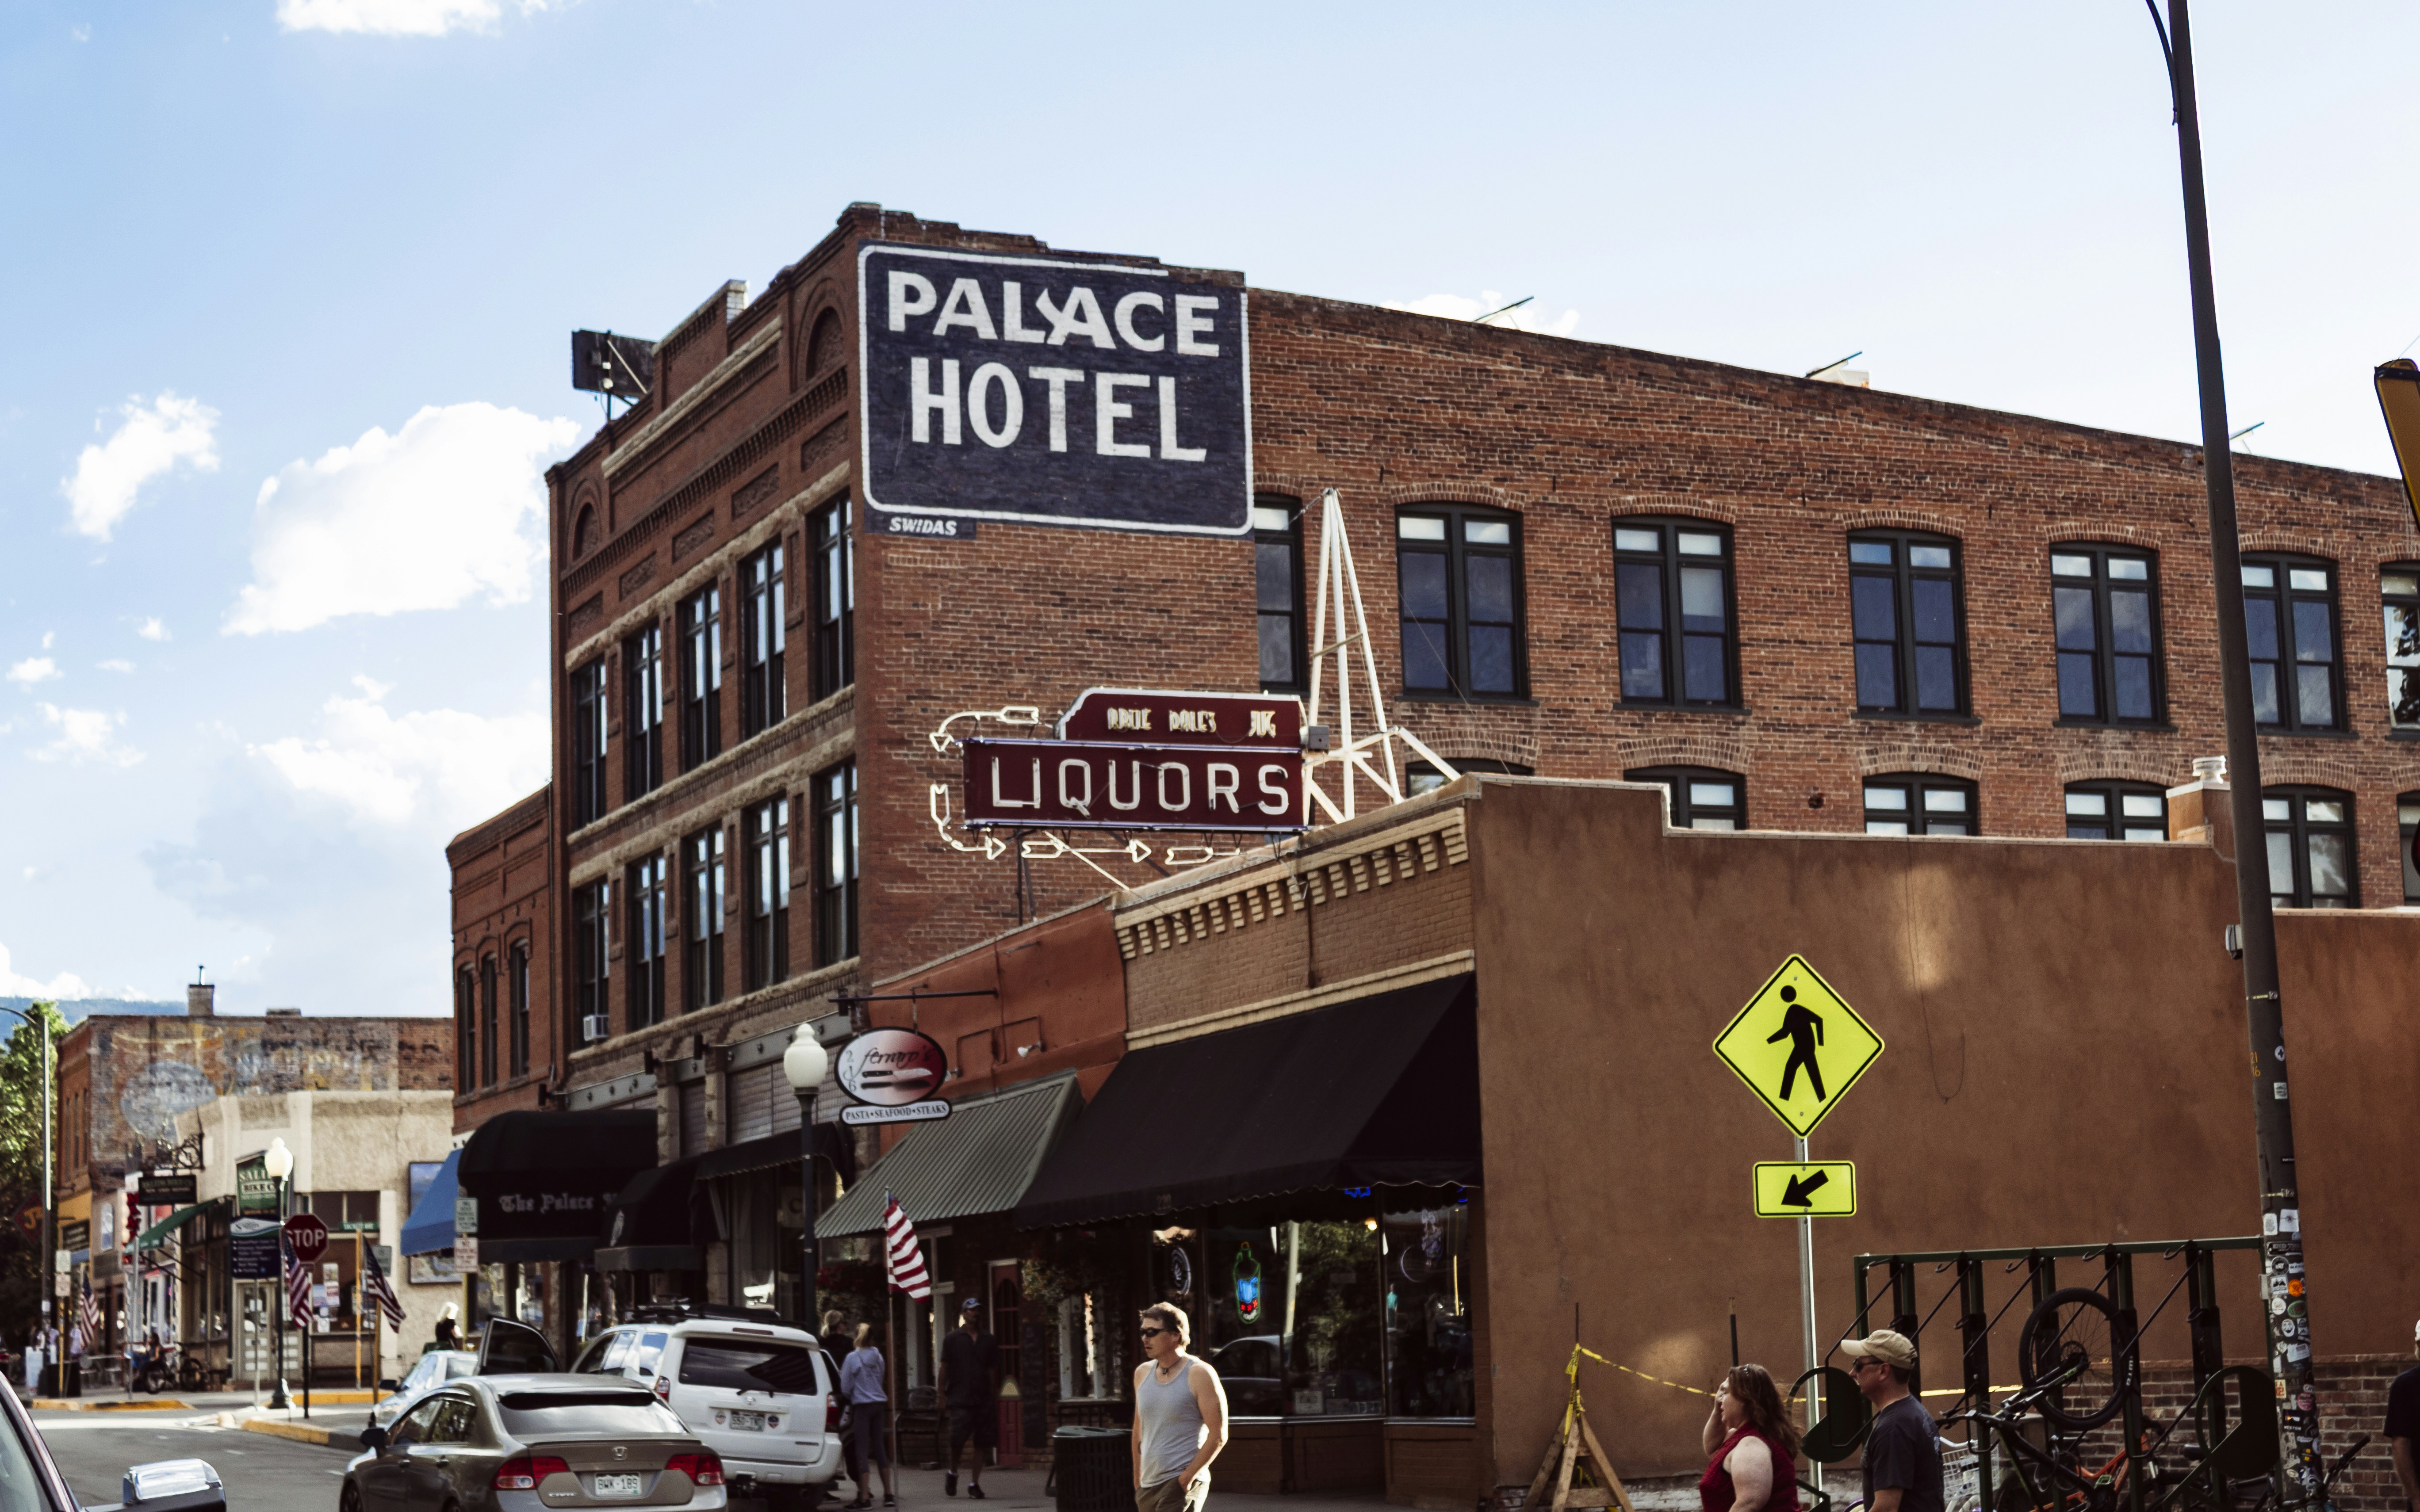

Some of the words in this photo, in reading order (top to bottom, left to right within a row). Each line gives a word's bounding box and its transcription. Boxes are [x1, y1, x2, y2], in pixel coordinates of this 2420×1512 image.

[888, 270, 1220, 357] PALACE
[911, 357, 1206, 462] HOTEL
[889, 516, 957, 536] SWIDAS
[1248, 710, 1276, 738] JUG
[992, 756, 1289, 818] LIQUORS
[846, 1110, 870, 1120] PASTA
[875, 1107, 911, 1118] SEAFOOD
[915, 1105, 946, 1115] STEAKS
[286, 1228, 325, 1248] STOP
